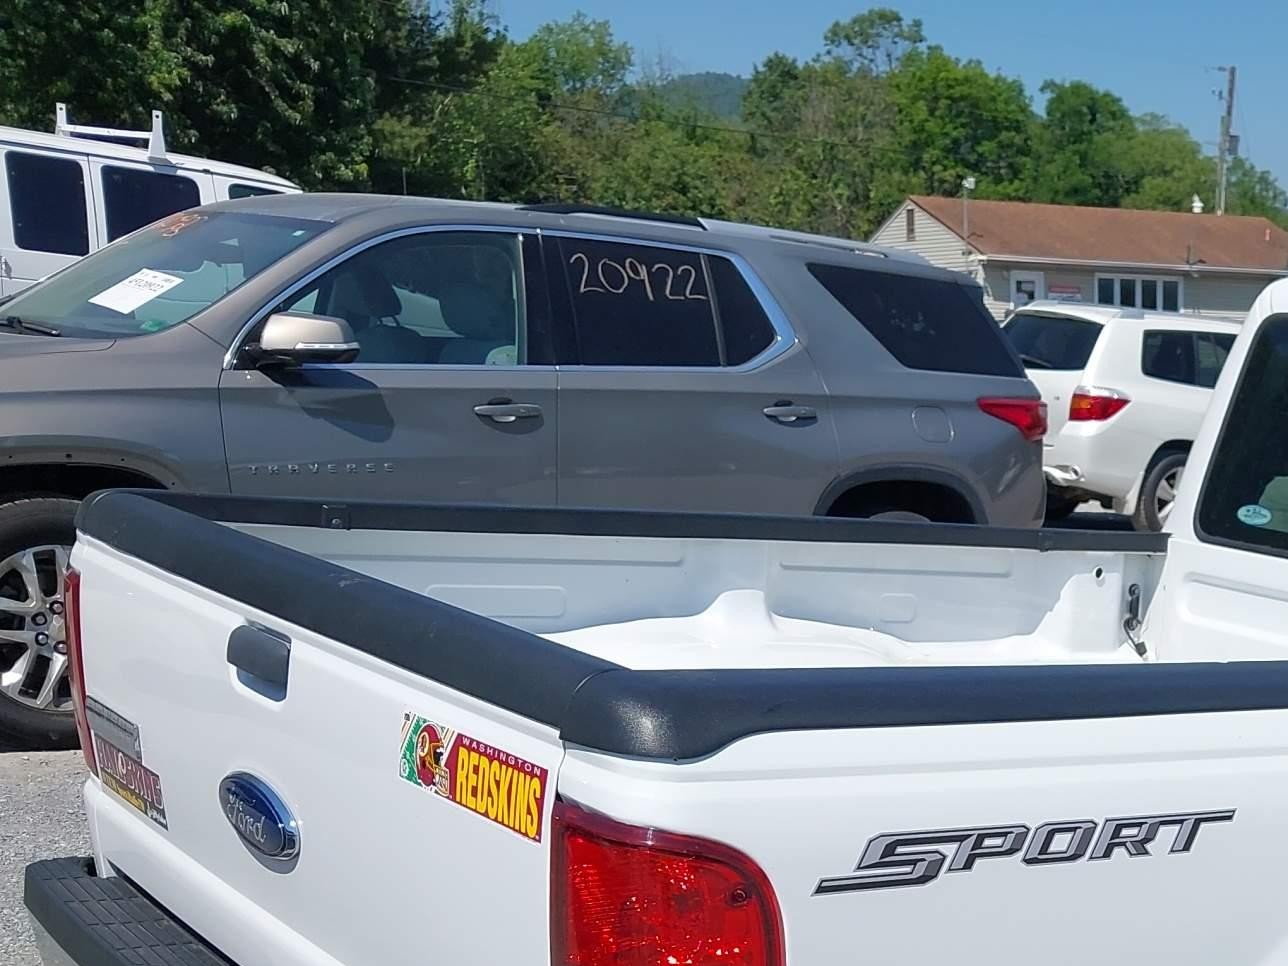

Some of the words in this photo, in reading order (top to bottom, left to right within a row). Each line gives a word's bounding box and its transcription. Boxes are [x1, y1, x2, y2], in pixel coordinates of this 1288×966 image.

[569, 252, 707, 301] 20922
[249, 462, 394, 476] TRAVERSE
[462, 736, 541, 776] WASHINGTON
[226, 784, 267, 843] Ford
[455, 746, 541, 838] REDSKINS
[810, 807, 1237, 897] SPORT
